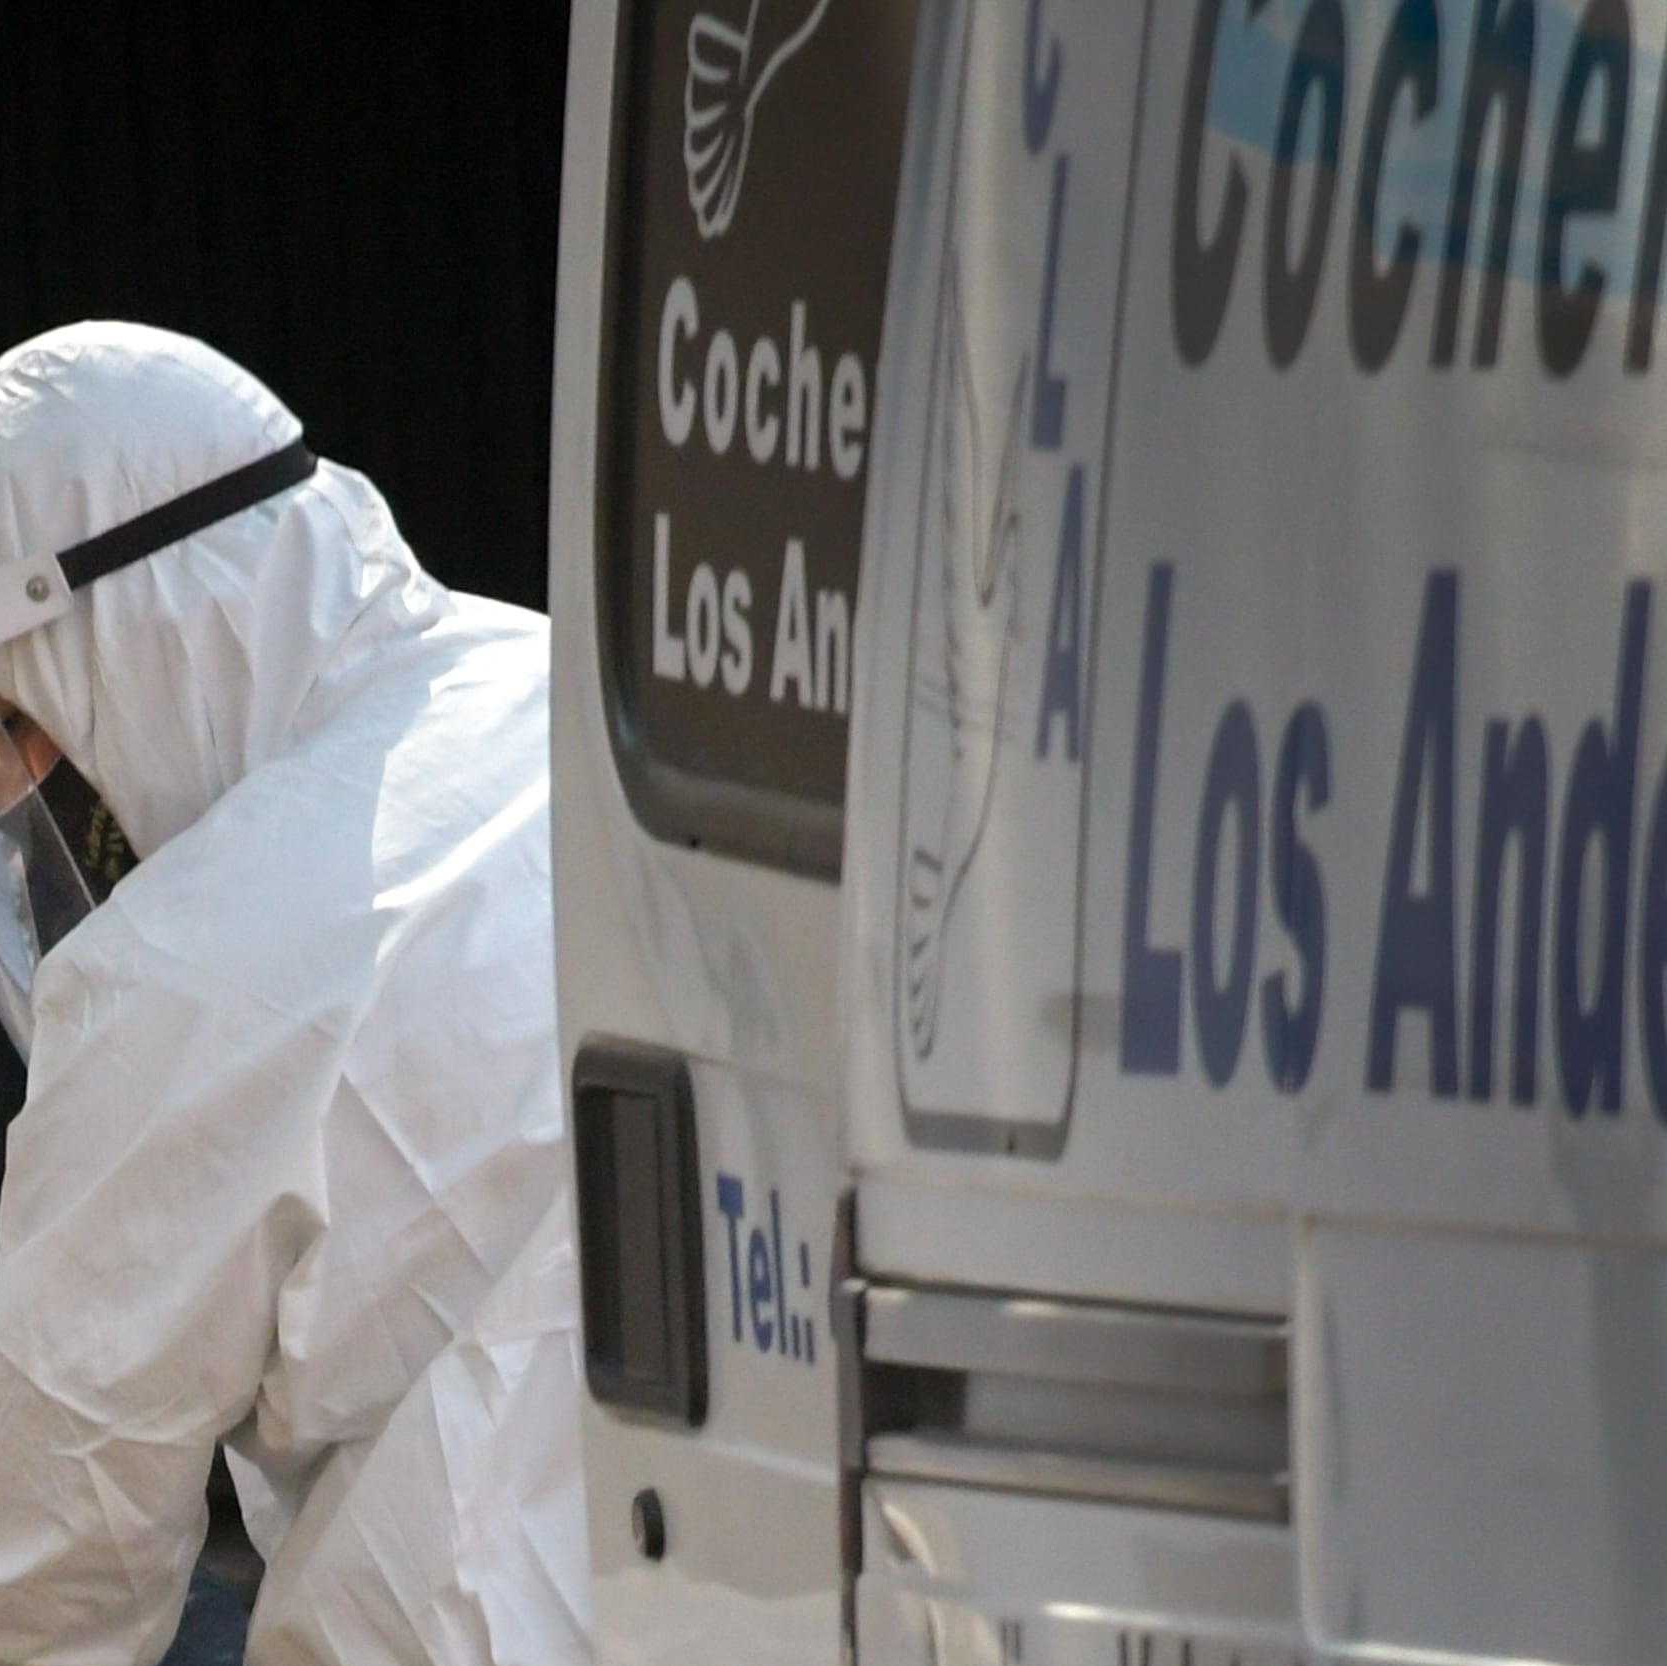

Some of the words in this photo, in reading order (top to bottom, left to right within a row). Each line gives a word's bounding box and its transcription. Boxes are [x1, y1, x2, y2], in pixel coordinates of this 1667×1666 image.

[657, 275, 866, 480] Coche
[652, 511, 754, 697] Los
[769, 538, 850, 715] An
[1118, 560, 1336, 1097] Los
